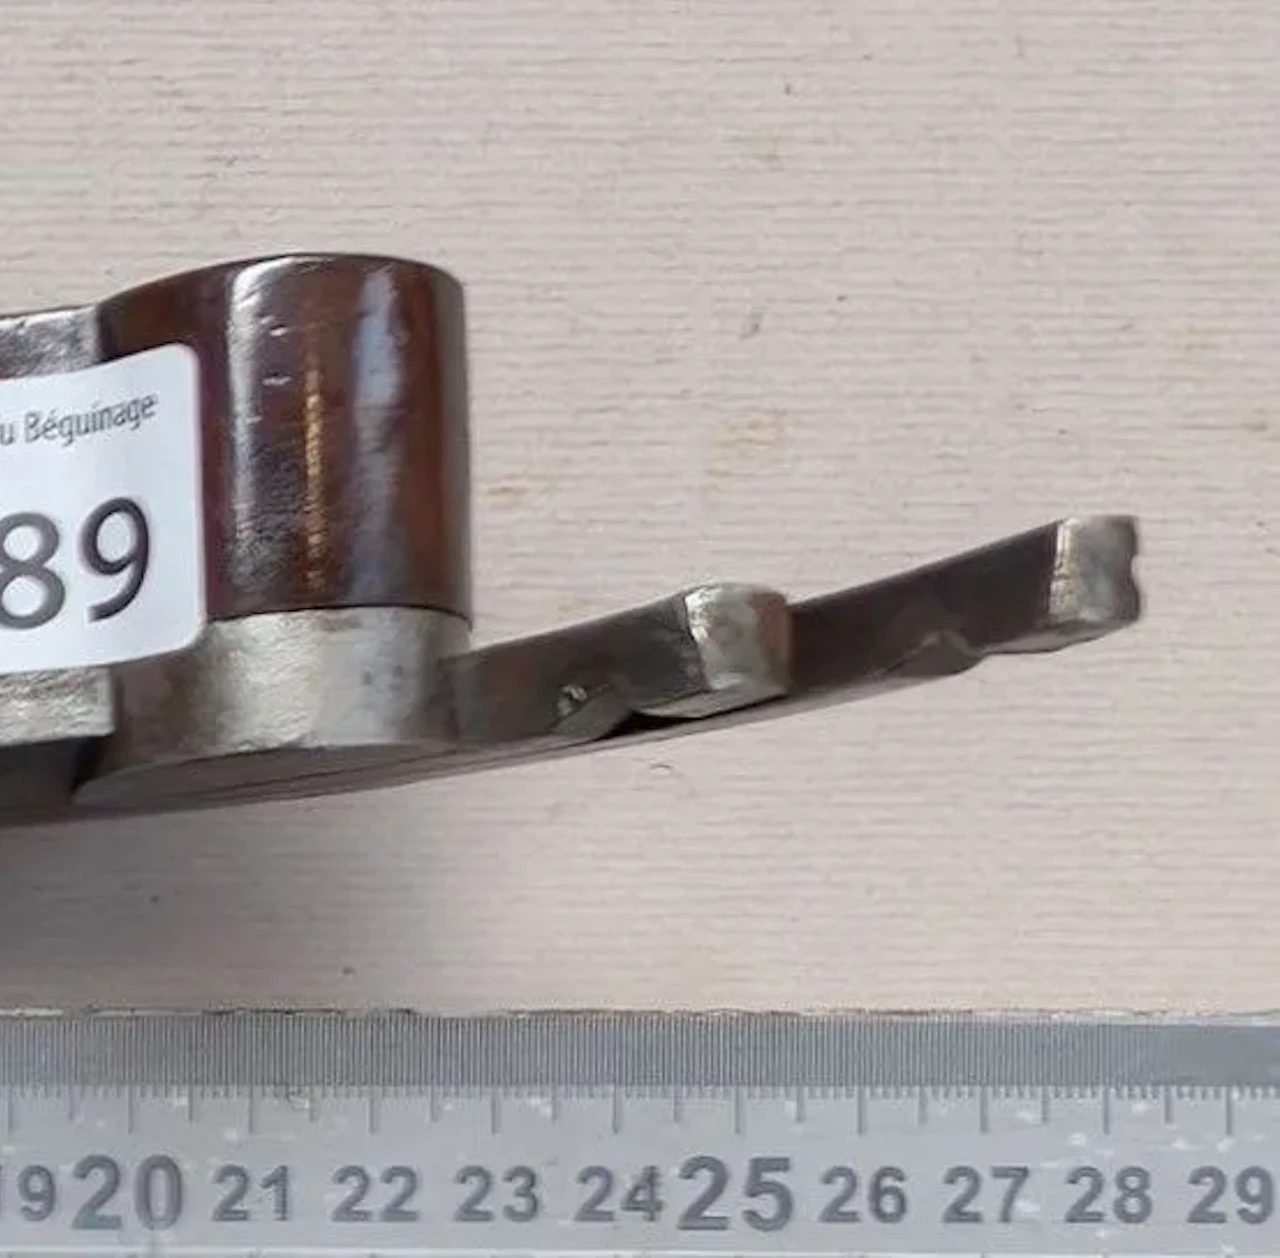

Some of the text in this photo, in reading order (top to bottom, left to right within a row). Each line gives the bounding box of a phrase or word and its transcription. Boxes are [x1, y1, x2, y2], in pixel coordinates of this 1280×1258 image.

[23, 395, 159, 448] Béguinage
[74, 1155, 184, 1231] 20
[212, 1164, 290, 1222] 21
[332, 1165, 420, 1223] 22
[454, 1165, 541, 1223] 23
[574, 1165, 664, 1223] 24
[676, 1155, 795, 1233] 25
[819, 1165, 908, 1224] 26
[942, 1165, 1031, 1225] 27
[1064, 1165, 1153, 1225] 28
[1186, 1165, 1275, 1226] 29
